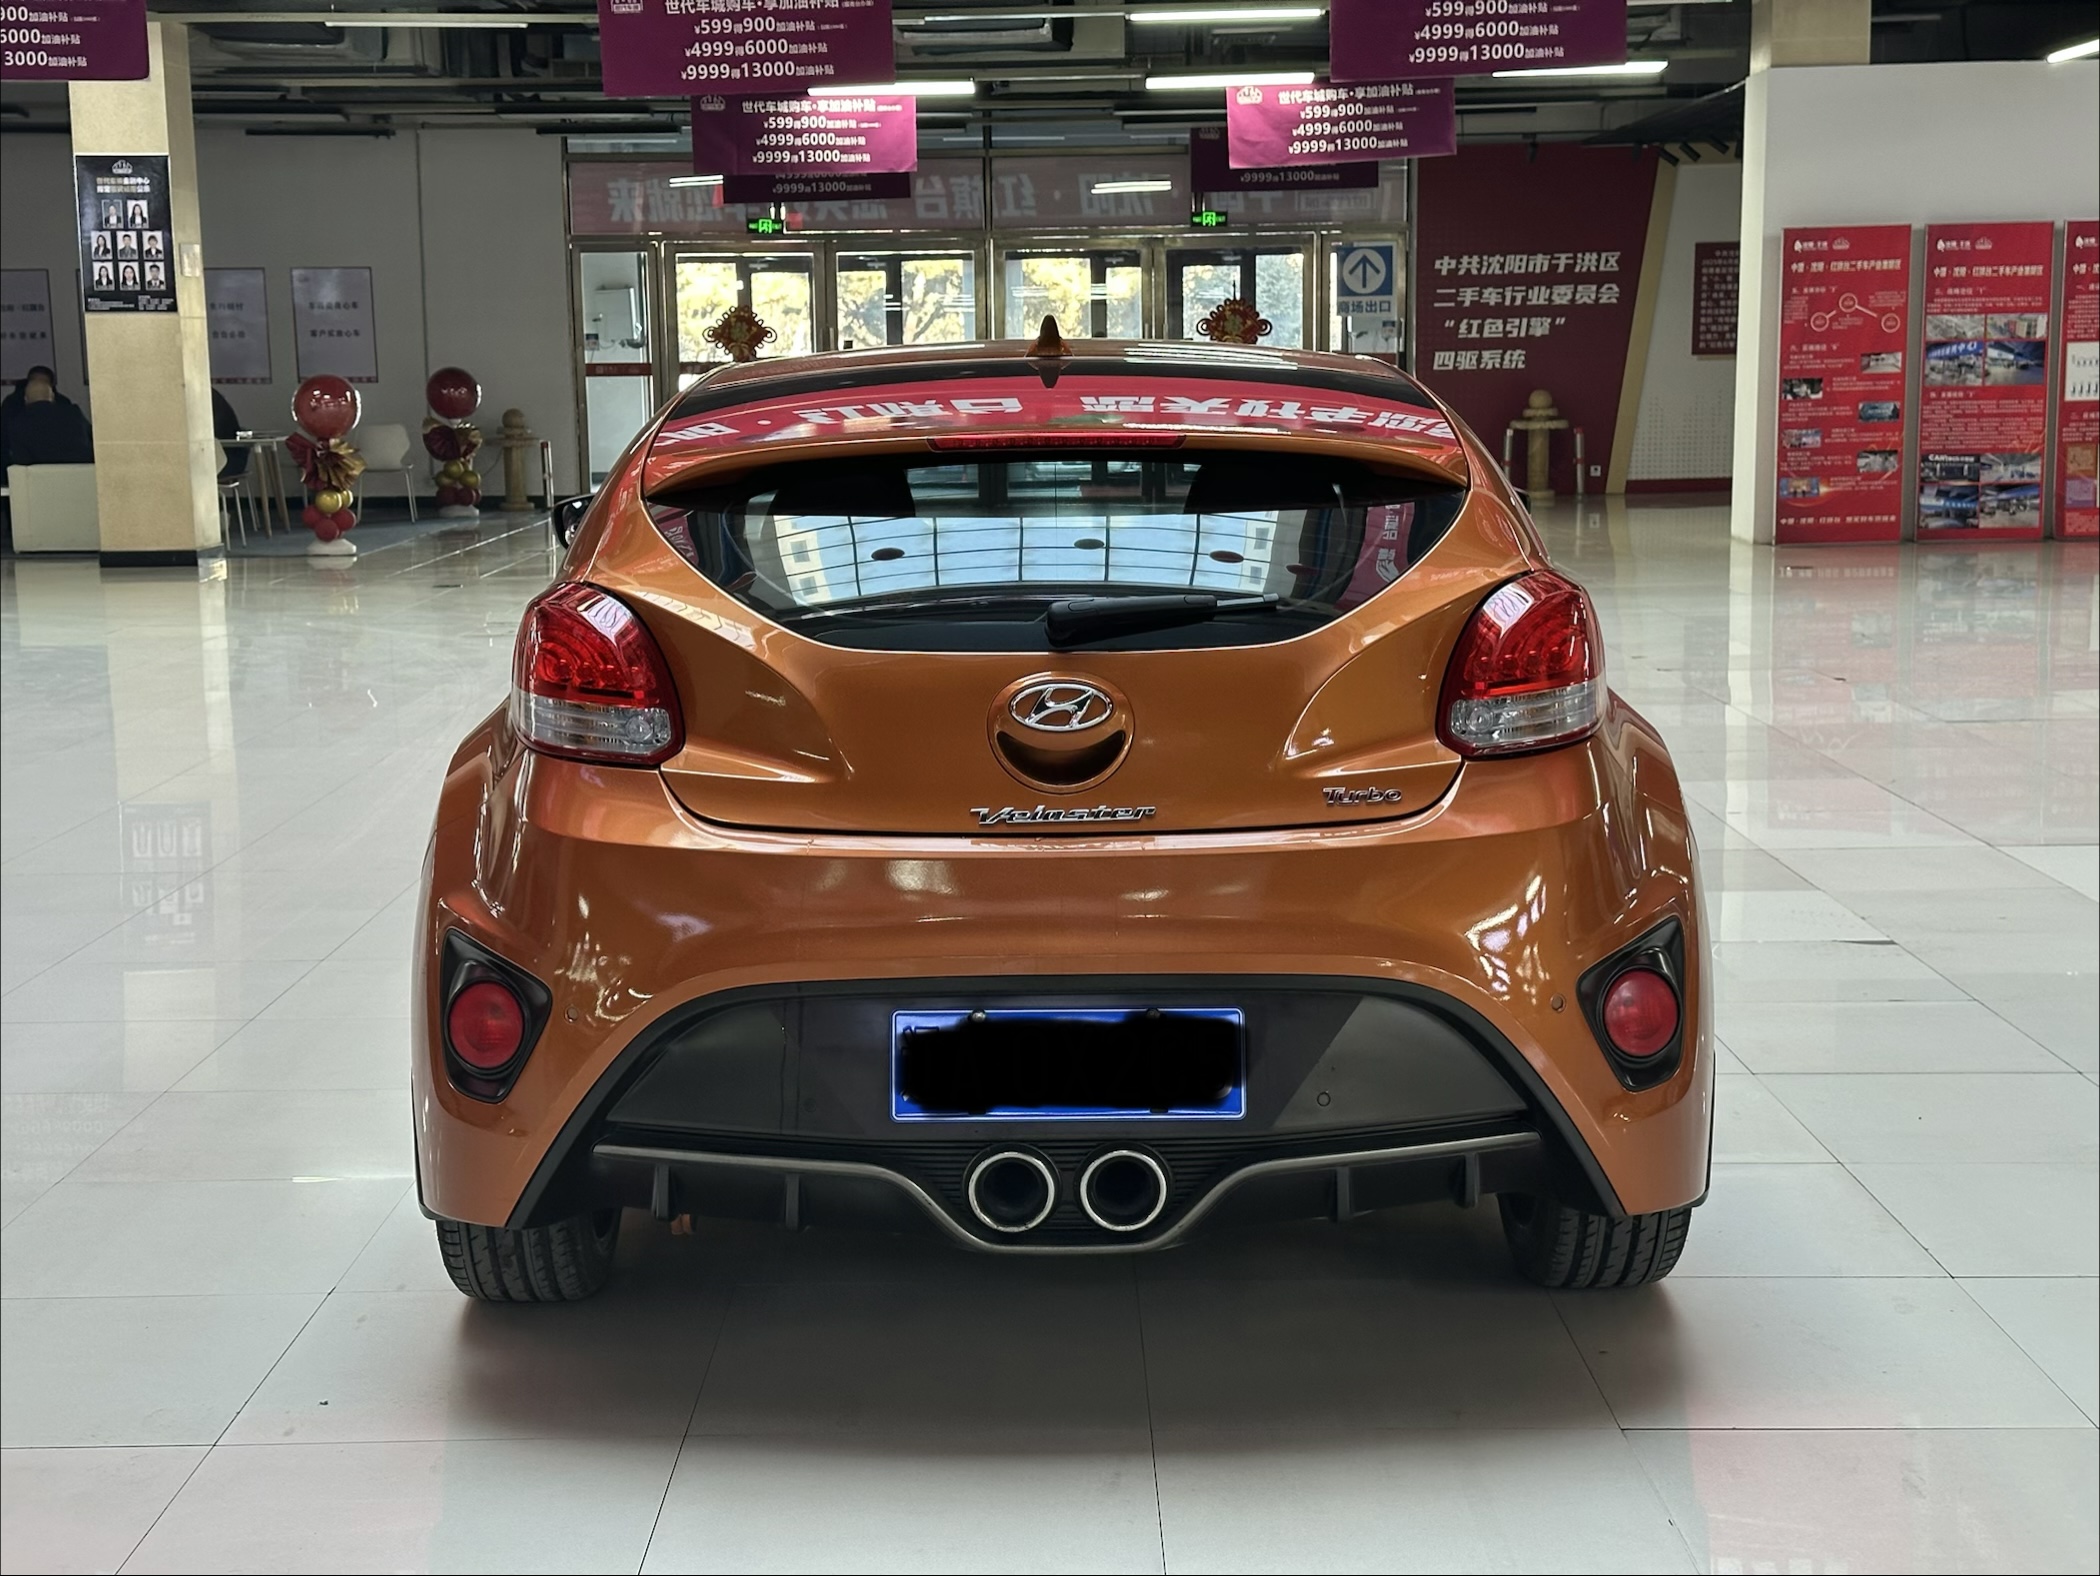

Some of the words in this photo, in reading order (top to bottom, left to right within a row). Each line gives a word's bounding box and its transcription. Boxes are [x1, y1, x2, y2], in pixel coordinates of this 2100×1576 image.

[694, 17, 815, 35] ¥599得900加油补贴
[1414, 20, 1559, 40] ¥4999得6000加油补贴
[684, 38, 828, 58] ¥4999得6000加油补贴
[1408, 43, 1565, 63] ¥9999得13000加油补贴
[681, 61, 835, 80] ¥9999得13000加油补贴
[1433, 252, 1621, 276] 中共沈阳市于洪区
[1433, 284, 1621, 307] 二手车行业委员会
[1338, 301, 1391, 313] 商场出口
[1444, 317, 1566, 338] “红色引擎”
[1433, 349, 1526, 370] 四驱系统
[1322, 786, 1403, 805] Turbo
[970, 804, 1156, 825] Veloster
